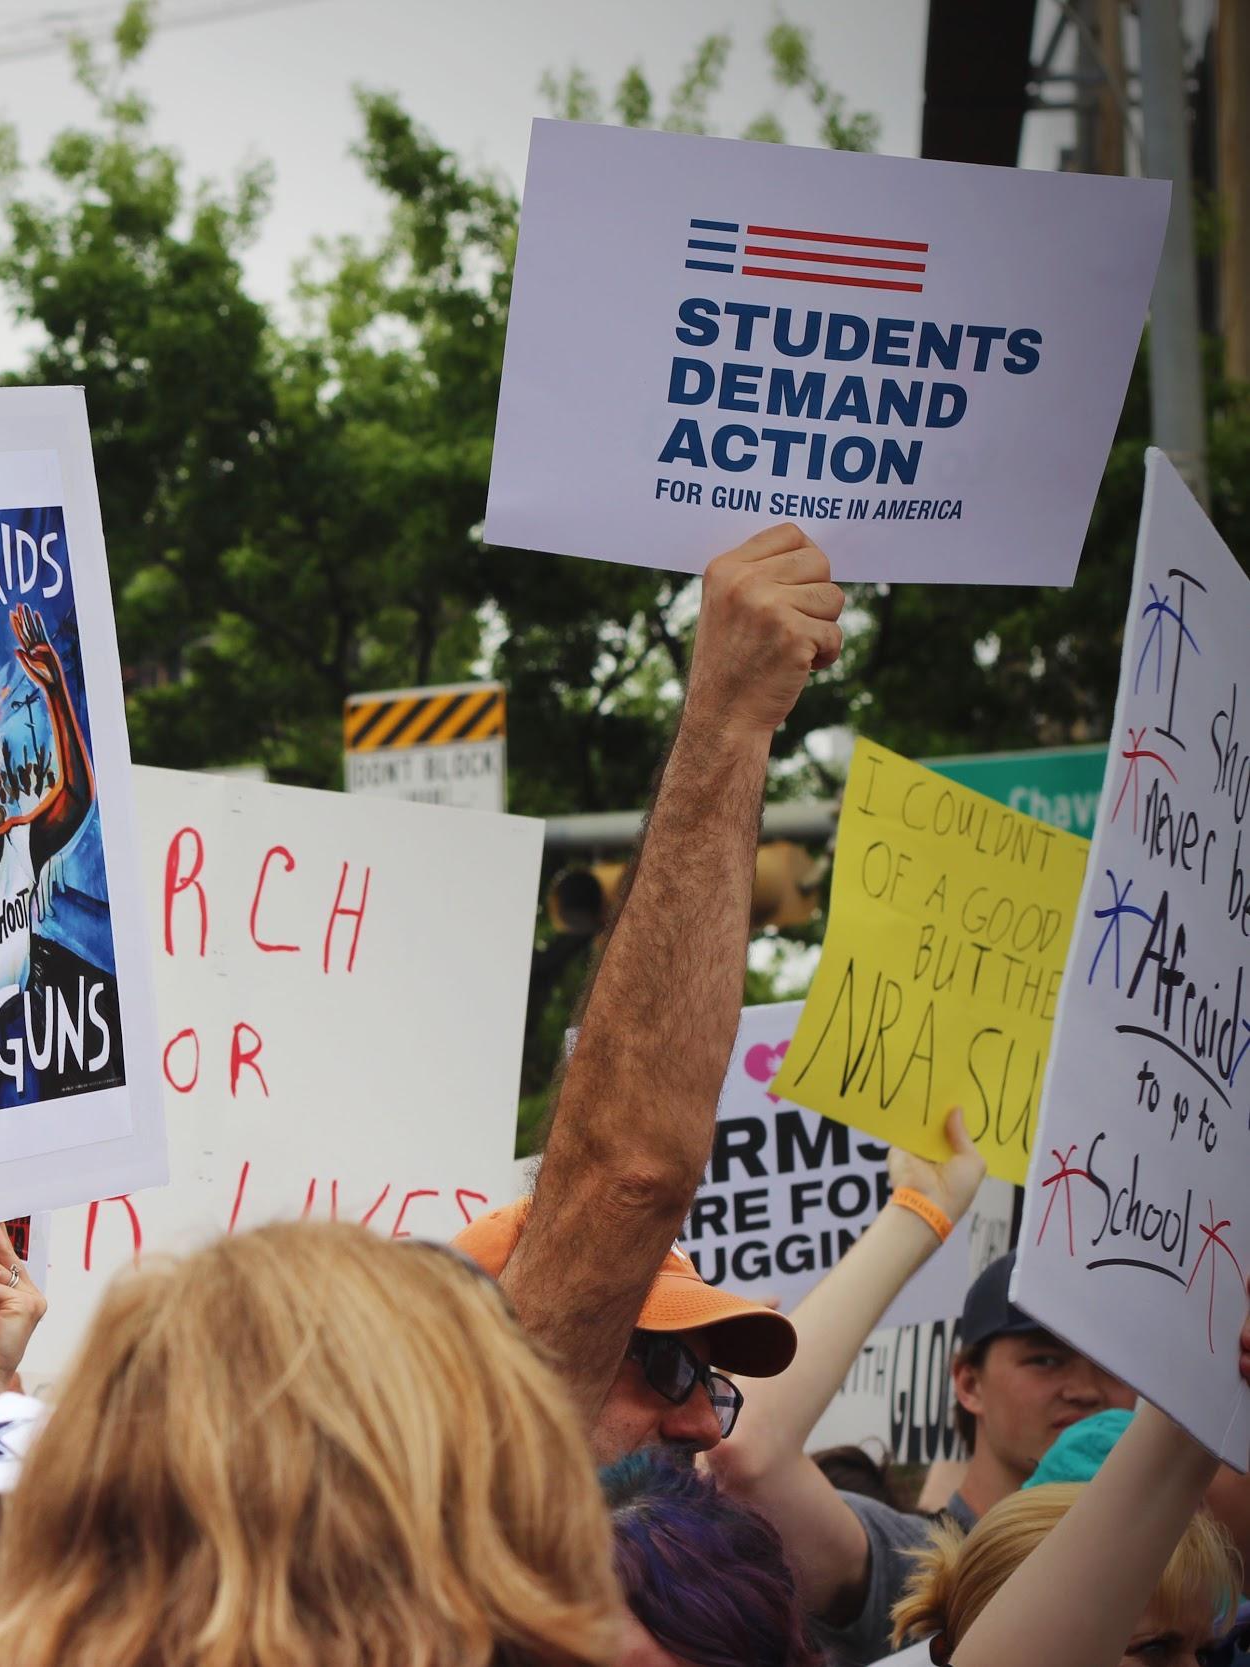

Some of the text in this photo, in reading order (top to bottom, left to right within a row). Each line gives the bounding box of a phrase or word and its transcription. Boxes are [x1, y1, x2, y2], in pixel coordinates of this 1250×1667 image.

[675, 297, 1043, 375] STUDENTS
[667, 356, 968, 429] DEMAND
[657, 417, 924, 485] ACTION
[655, 478, 963, 520] FOR GUN SENSE IN AMERICA
[1155, 568, 1208, 751] I
[858, 755, 1056, 872] I COULDNT
[1009, 784, 1100, 830] Chav
[1143, 777, 1216, 886] never
[862, 840, 1062, 953] OF A GOOD
[913, 923, 1064, 1021] BUT THE
[1127, 890, 1243, 1081] Afraid
[793, 957, 935, 1128] NRA
[1137, 1060, 1217, 1153] to go to
[680, 1187, 771, 1242] RE
[1086, 1131, 1193, 1268] School
[839, 1346, 888, 1397] ITH
